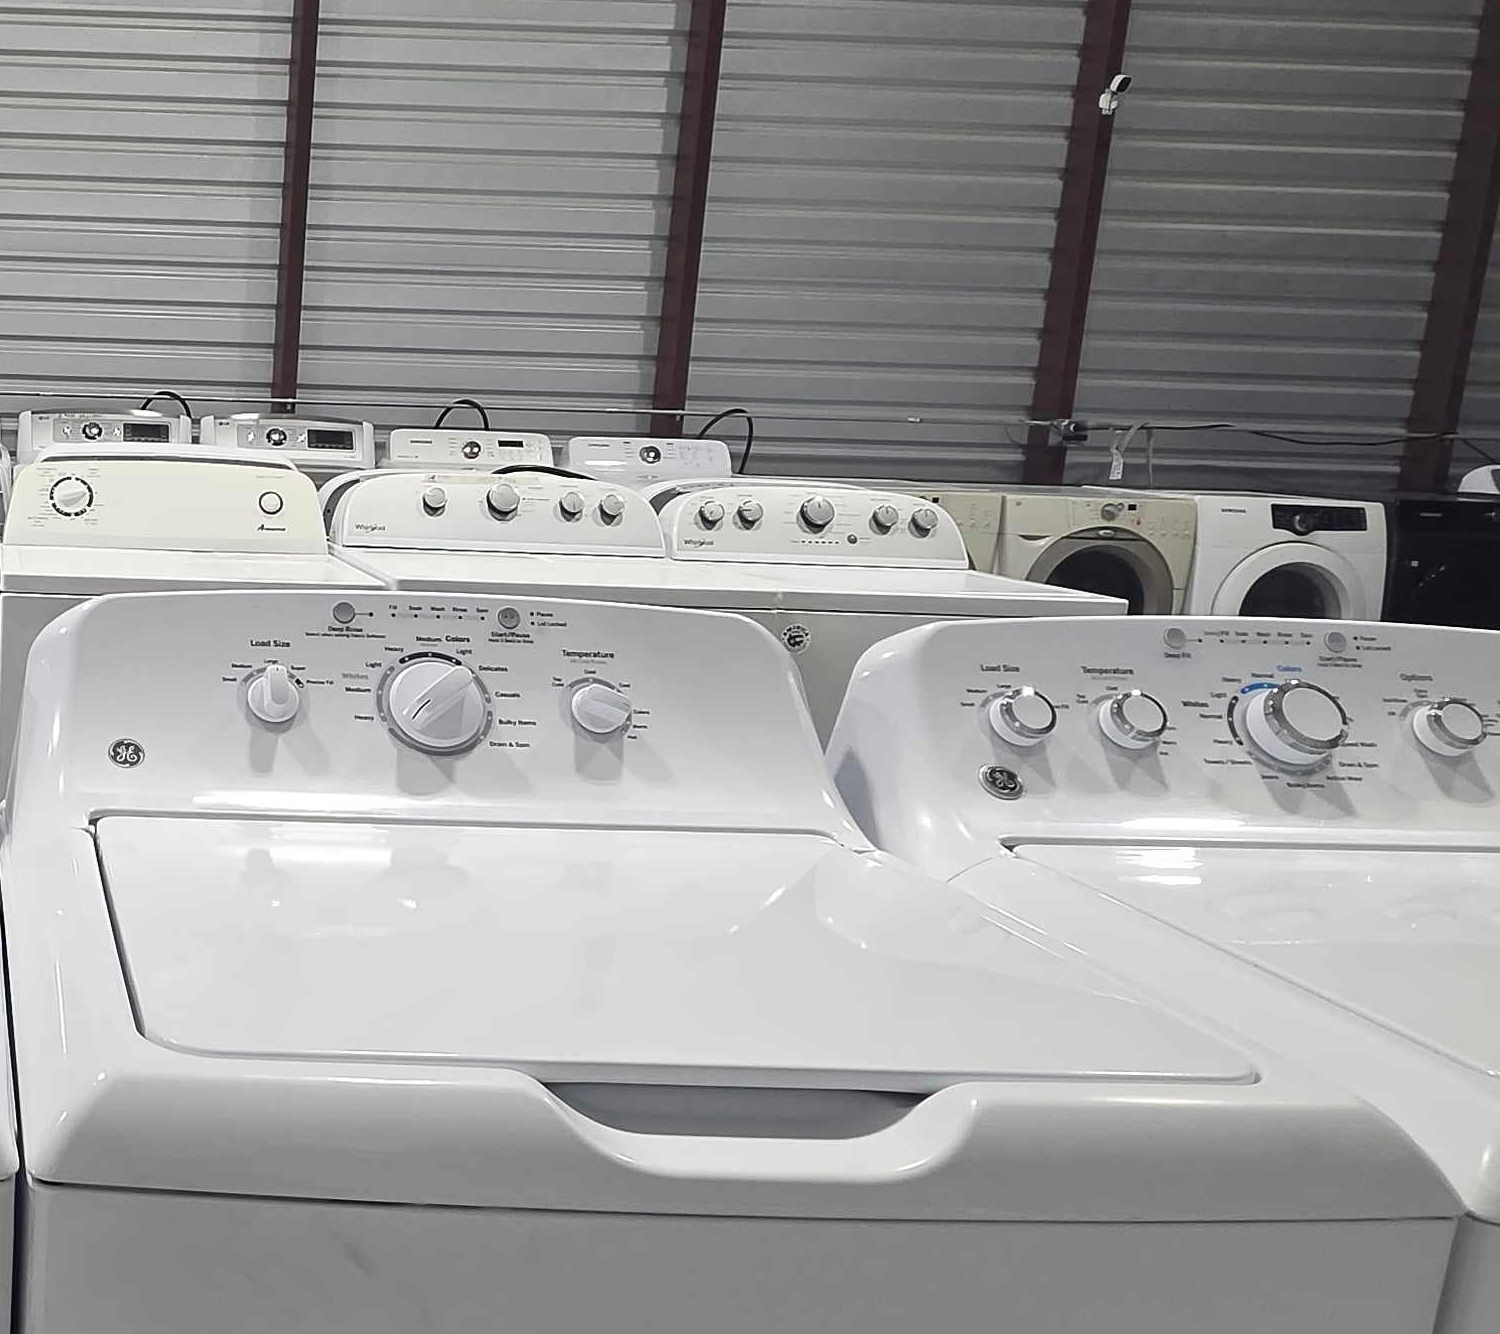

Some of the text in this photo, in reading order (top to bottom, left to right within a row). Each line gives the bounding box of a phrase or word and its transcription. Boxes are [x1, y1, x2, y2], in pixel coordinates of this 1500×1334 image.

[355, 523, 386, 533] Whirlpool
[683, 538, 715, 548] Whirlpool
[416, 635, 470, 643] Medium Colors
[491, 631, 530, 639] Start/Pause
[250, 639, 291, 647] Load Size
[562, 649, 615, 658] Temperature
[980, 664, 1020, 672] Load Size
[1081, 666, 1134, 675] Temperature
[1277, 665, 1302, 673] Colors
[1400, 673, 1433, 681] Options
[354, 714, 374, 722] Heavy
